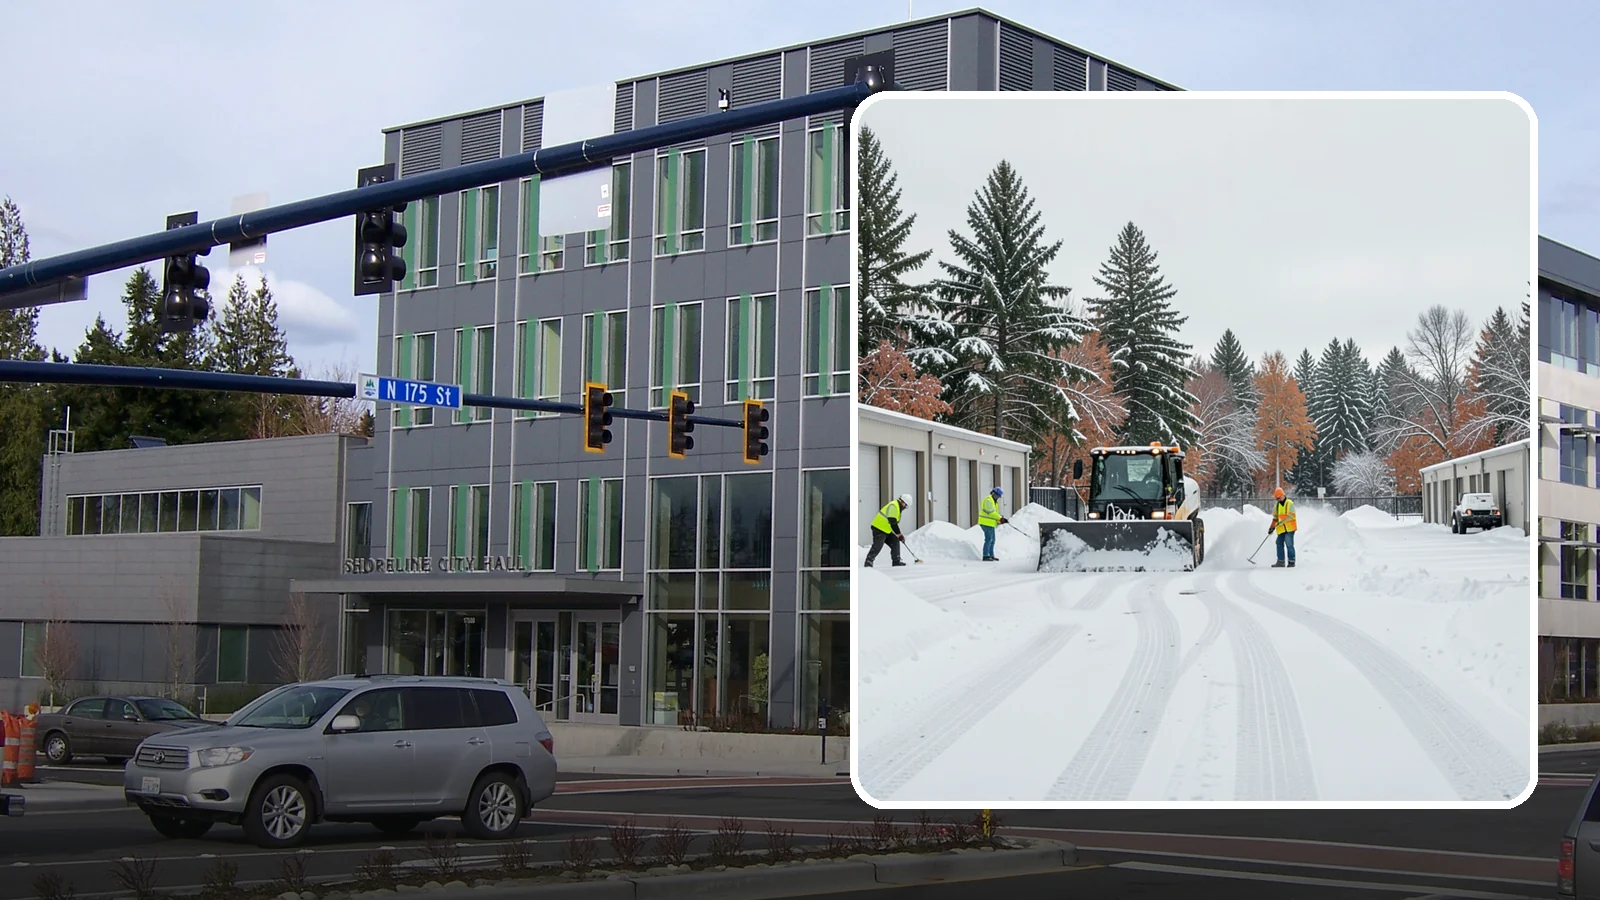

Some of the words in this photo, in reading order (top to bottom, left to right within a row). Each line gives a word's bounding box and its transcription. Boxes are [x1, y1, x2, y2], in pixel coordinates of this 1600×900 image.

[387, 380, 396, 400] N
[405, 382, 427, 403] 175
[436, 386, 451, 406] St
[344, 556, 432, 574] SHORELINE
[438, 556, 475, 572] CITY
[483, 555, 526, 572] HALL
